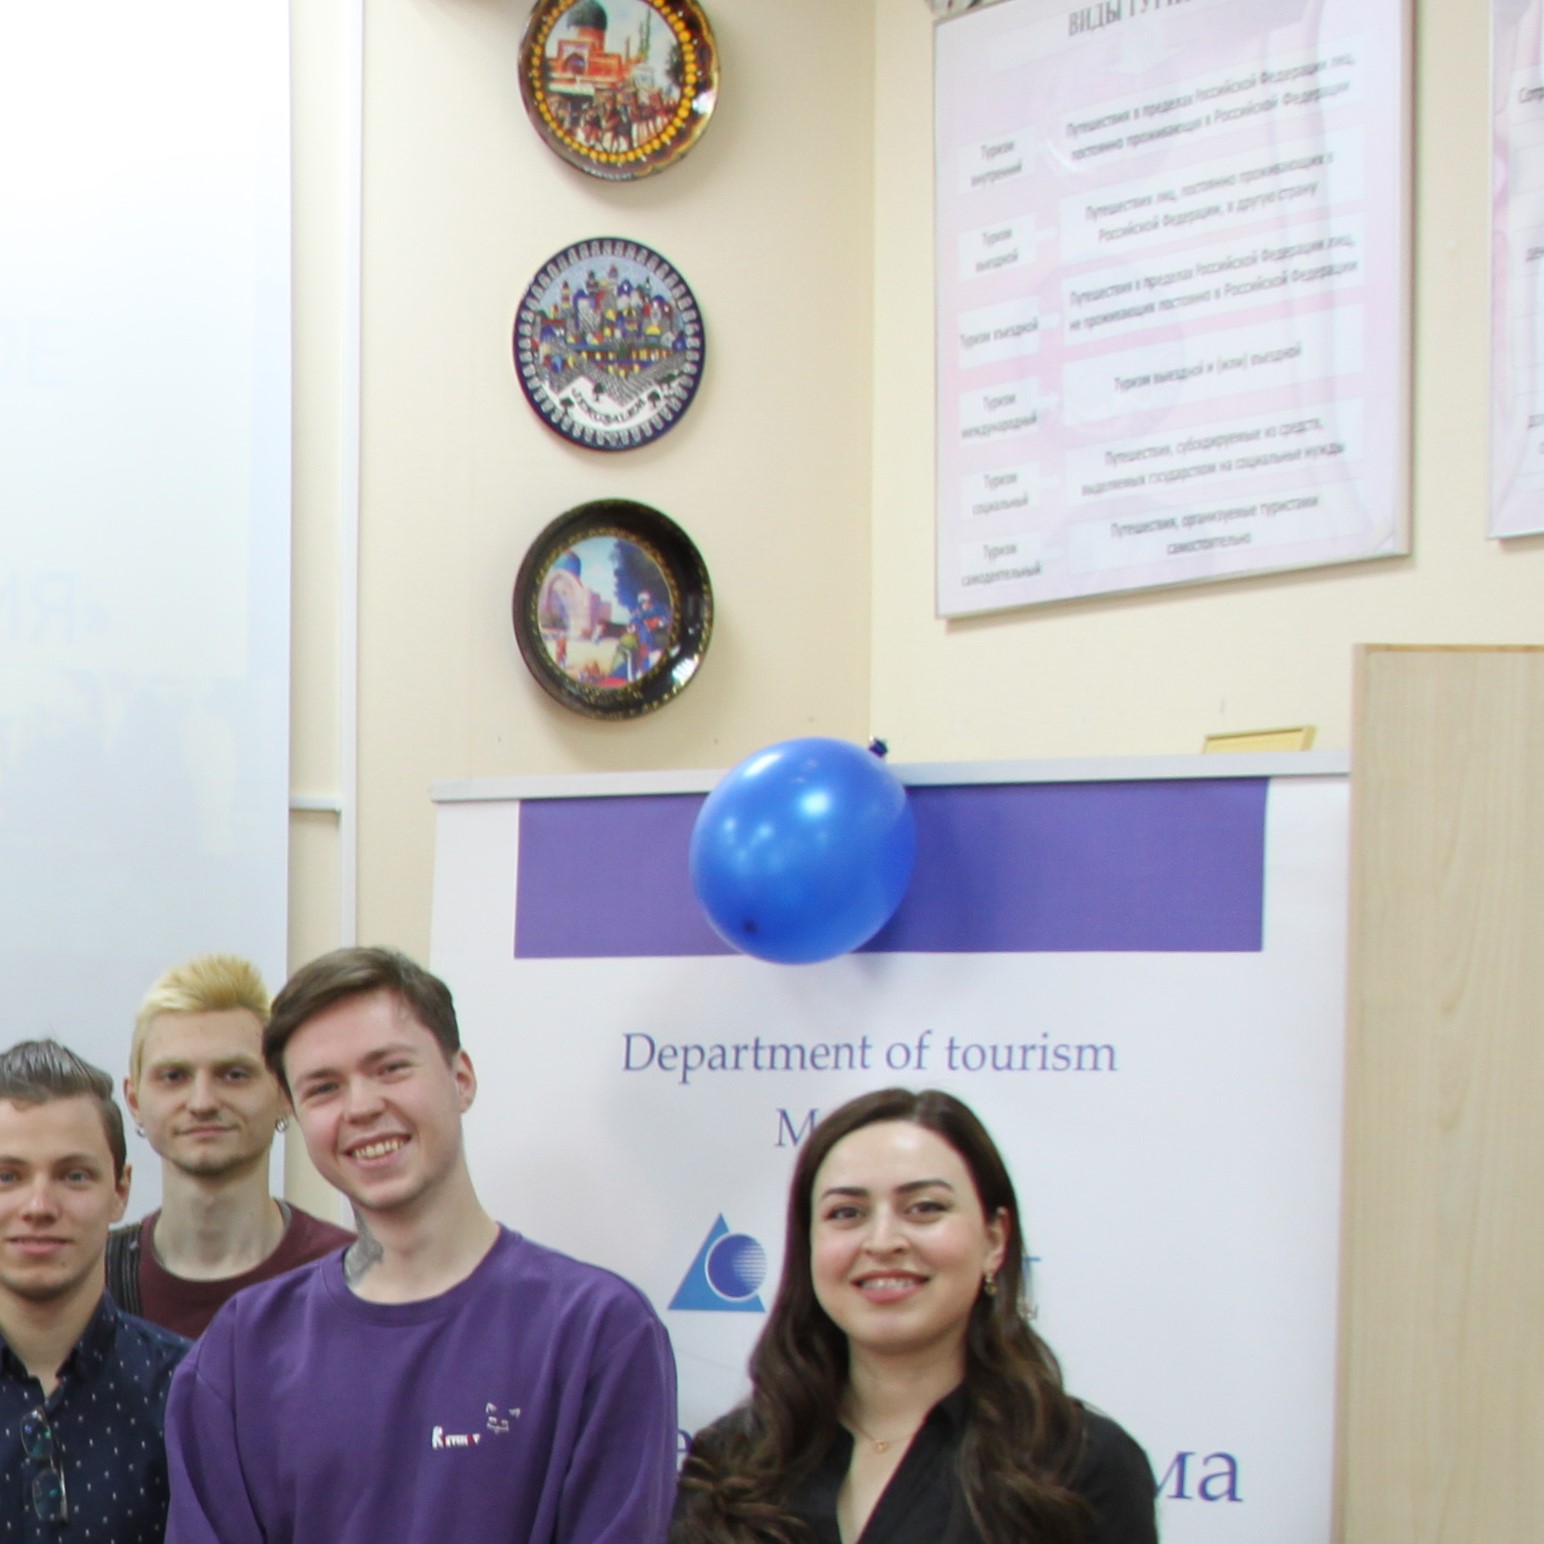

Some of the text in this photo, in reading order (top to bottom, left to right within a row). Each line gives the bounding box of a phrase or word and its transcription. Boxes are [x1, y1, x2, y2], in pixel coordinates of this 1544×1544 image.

[621, 1030, 1119, 1085] Department of tourism
